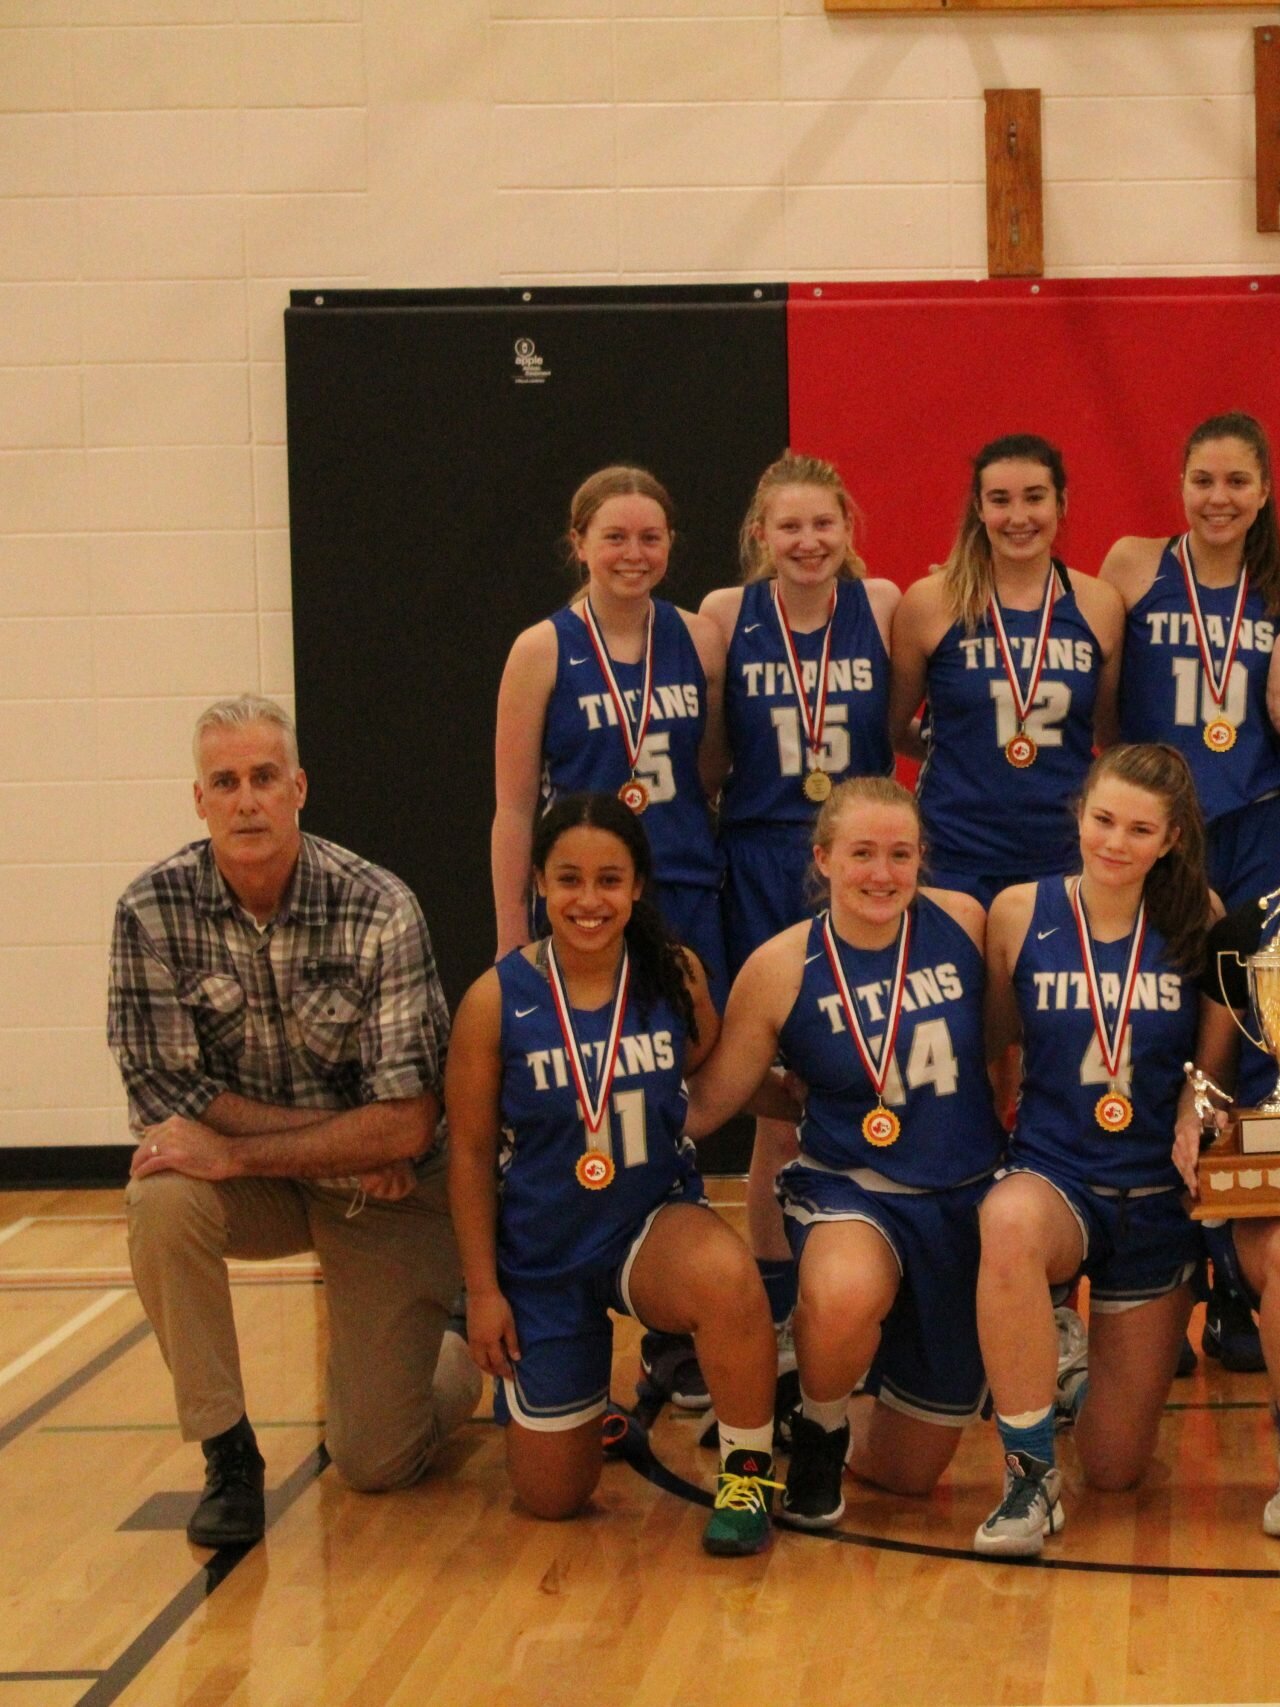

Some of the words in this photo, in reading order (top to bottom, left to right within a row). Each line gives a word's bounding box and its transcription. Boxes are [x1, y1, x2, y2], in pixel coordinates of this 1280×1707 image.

[514, 355, 544, 367] apple
[958, 636, 1094, 673] TIANS
[989, 679, 1072, 748] 12
[1171, 656, 1249, 728] 10
[635, 732, 678, 805] 5
[769, 704, 851, 777] 15
[816, 962, 964, 1035] TTANS
[1033, 971, 1182, 1011] TITANS
[1079, 1024, 1135, 1099] 4
